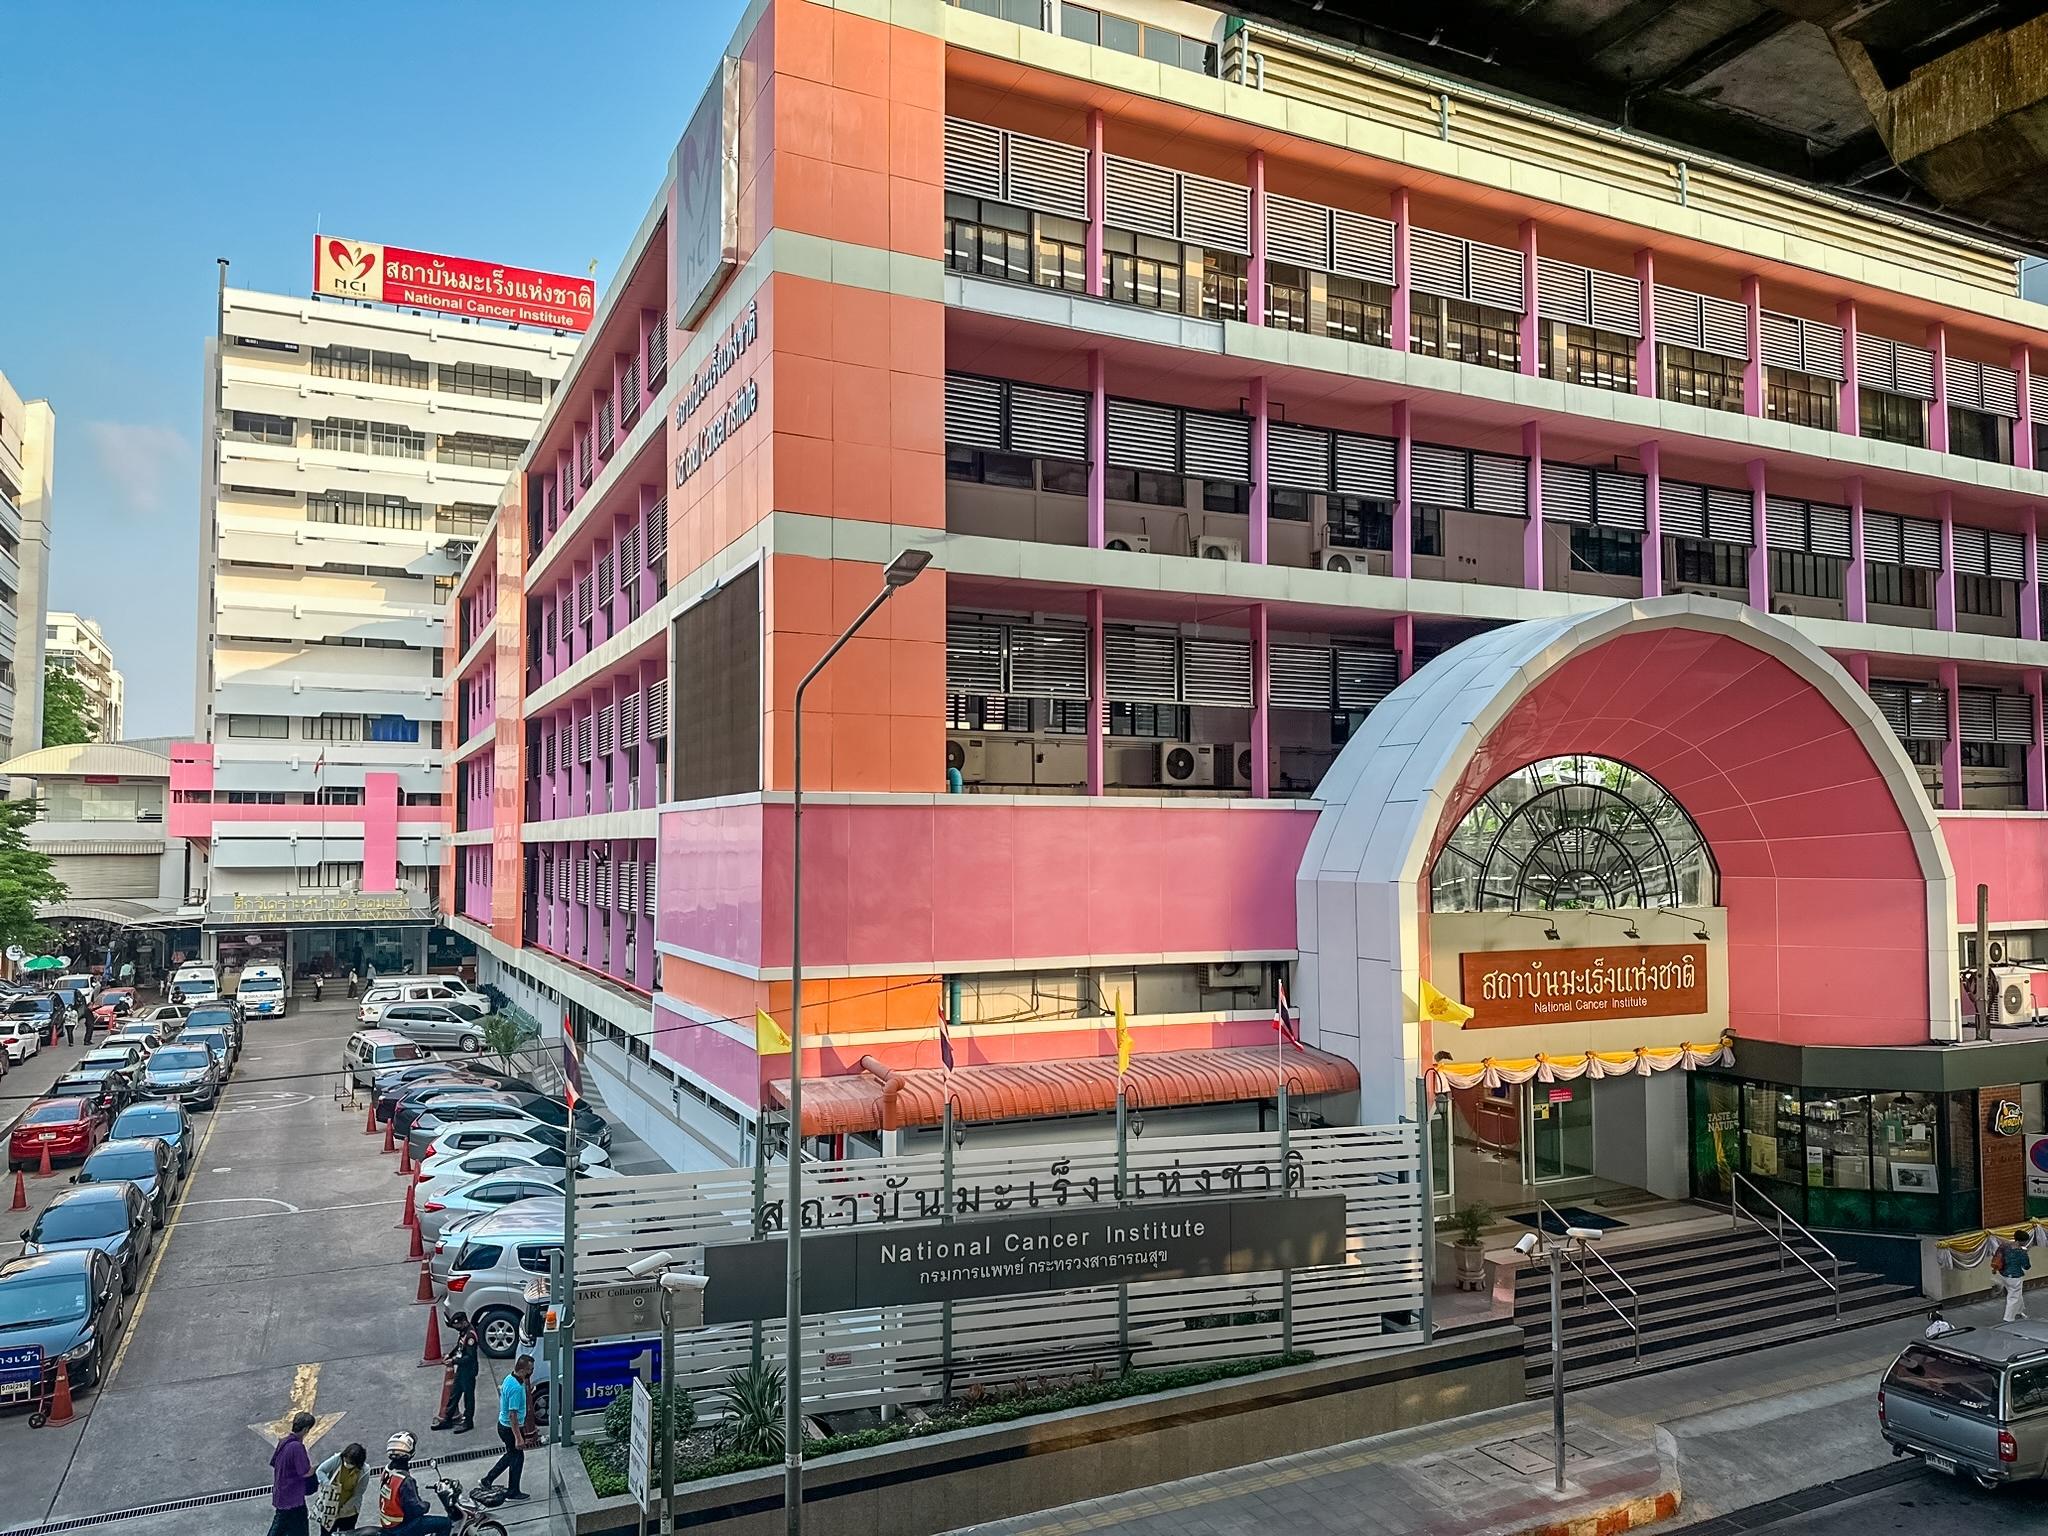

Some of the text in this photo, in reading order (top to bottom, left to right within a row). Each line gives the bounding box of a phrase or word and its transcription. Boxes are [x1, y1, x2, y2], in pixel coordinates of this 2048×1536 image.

[335, 278, 366, 292] NCI
[386, 260, 591, 309] สถาบันมะเร็งแห่งชาติ
[404, 289, 574, 327] National Cancer Institute
[675, 378, 758, 490] National Cancer Institute
[1482, 954, 1695, 1001] สถาบันมะเร็งแห่งชาติ
[1534, 996, 1648, 1014] National Cancer Institute
[1708, 1111, 1731, 1122] TASTE
[759, 1149, 1307, 1233] สถาบันมะเร็งแห่งชาติ
[880, 1219, 1206, 1264] National Cancer Institute
[919, 1249, 1168, 1284] กรมการแพทย์ กระทรวงสาธารณสุข
[578, 1290, 605, 1301] IARC
